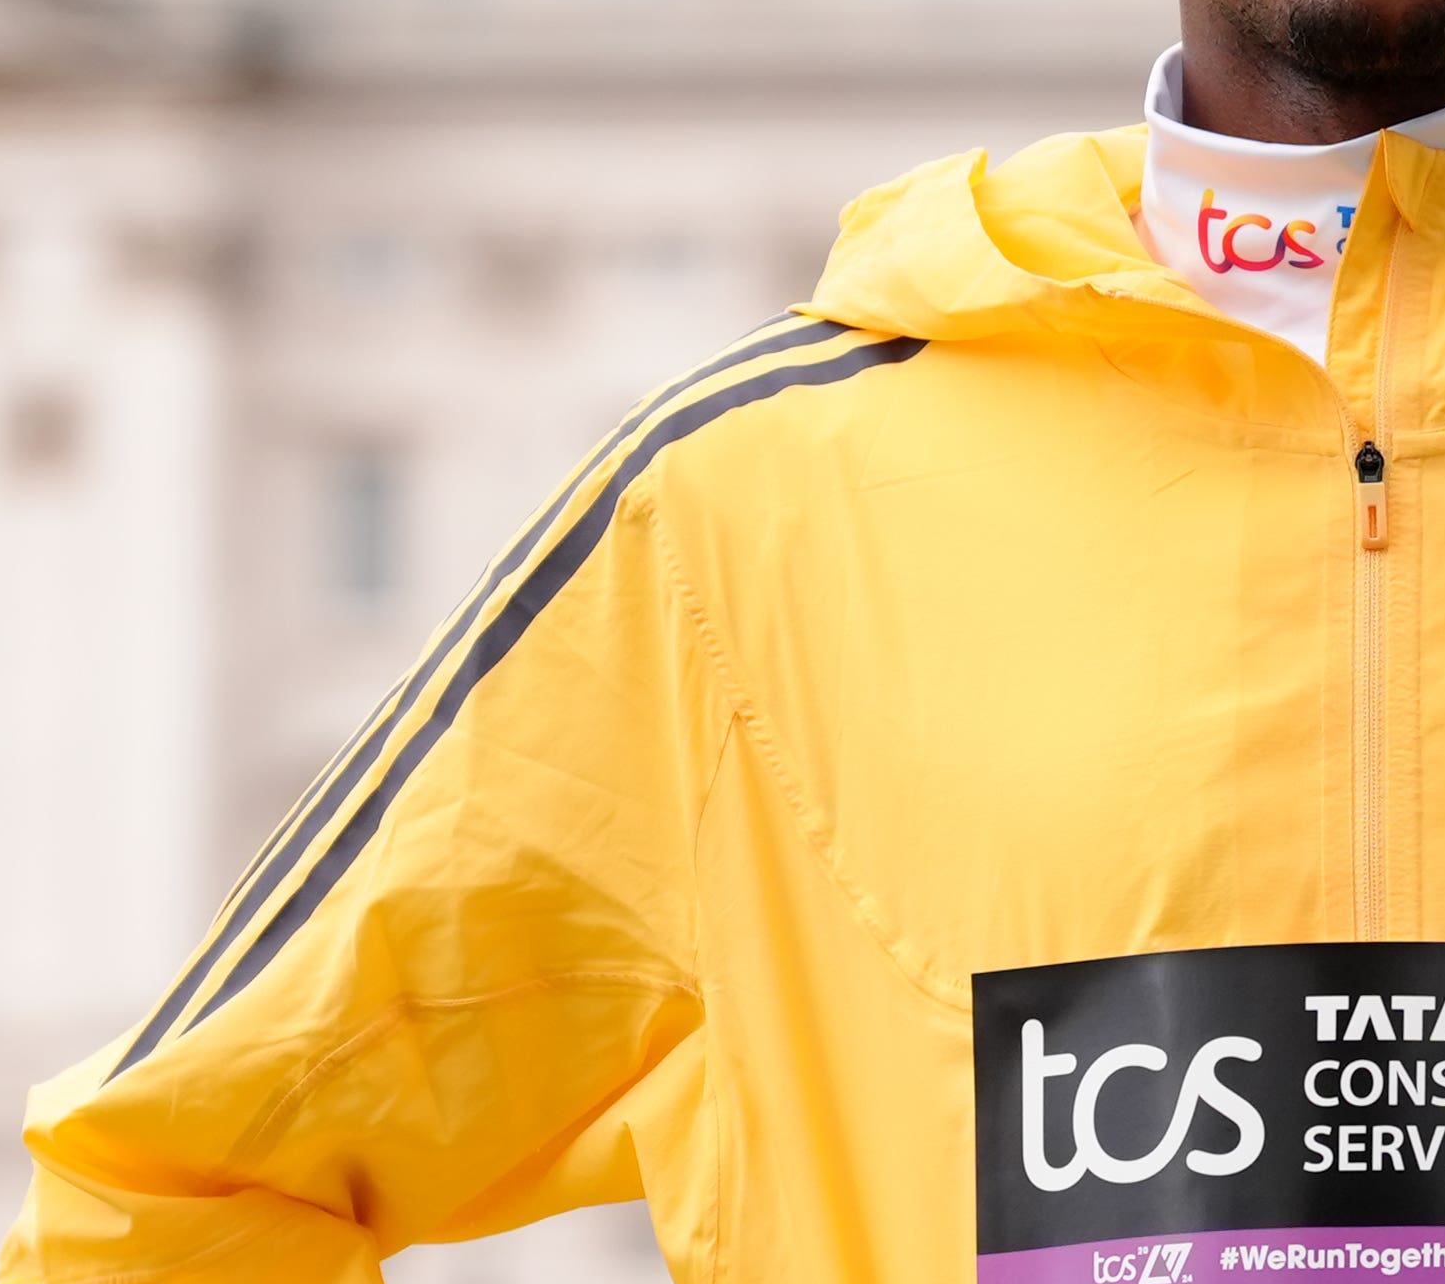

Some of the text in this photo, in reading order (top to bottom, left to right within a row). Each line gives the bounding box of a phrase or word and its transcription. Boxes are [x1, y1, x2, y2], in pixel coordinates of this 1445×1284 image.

[1198, 188, 1324, 274] tcs
[1022, 1019, 1264, 1191] tcs
[1094, 1251, 1136, 1284] tcs
